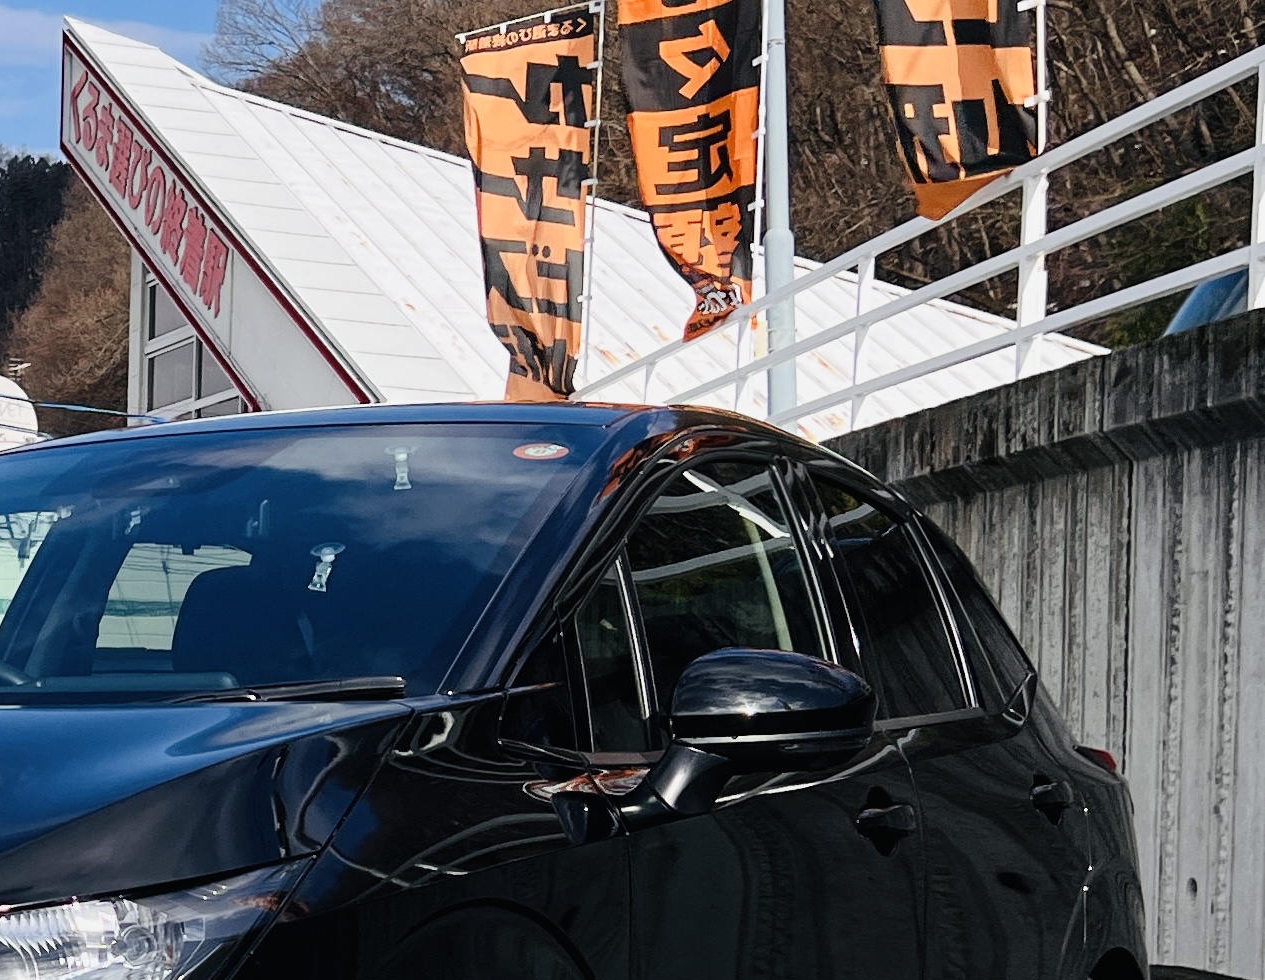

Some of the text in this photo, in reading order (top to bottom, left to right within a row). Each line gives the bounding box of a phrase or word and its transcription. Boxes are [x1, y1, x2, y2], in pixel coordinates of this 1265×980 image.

[70, 70, 230, 319] くるま選びの終着駅
